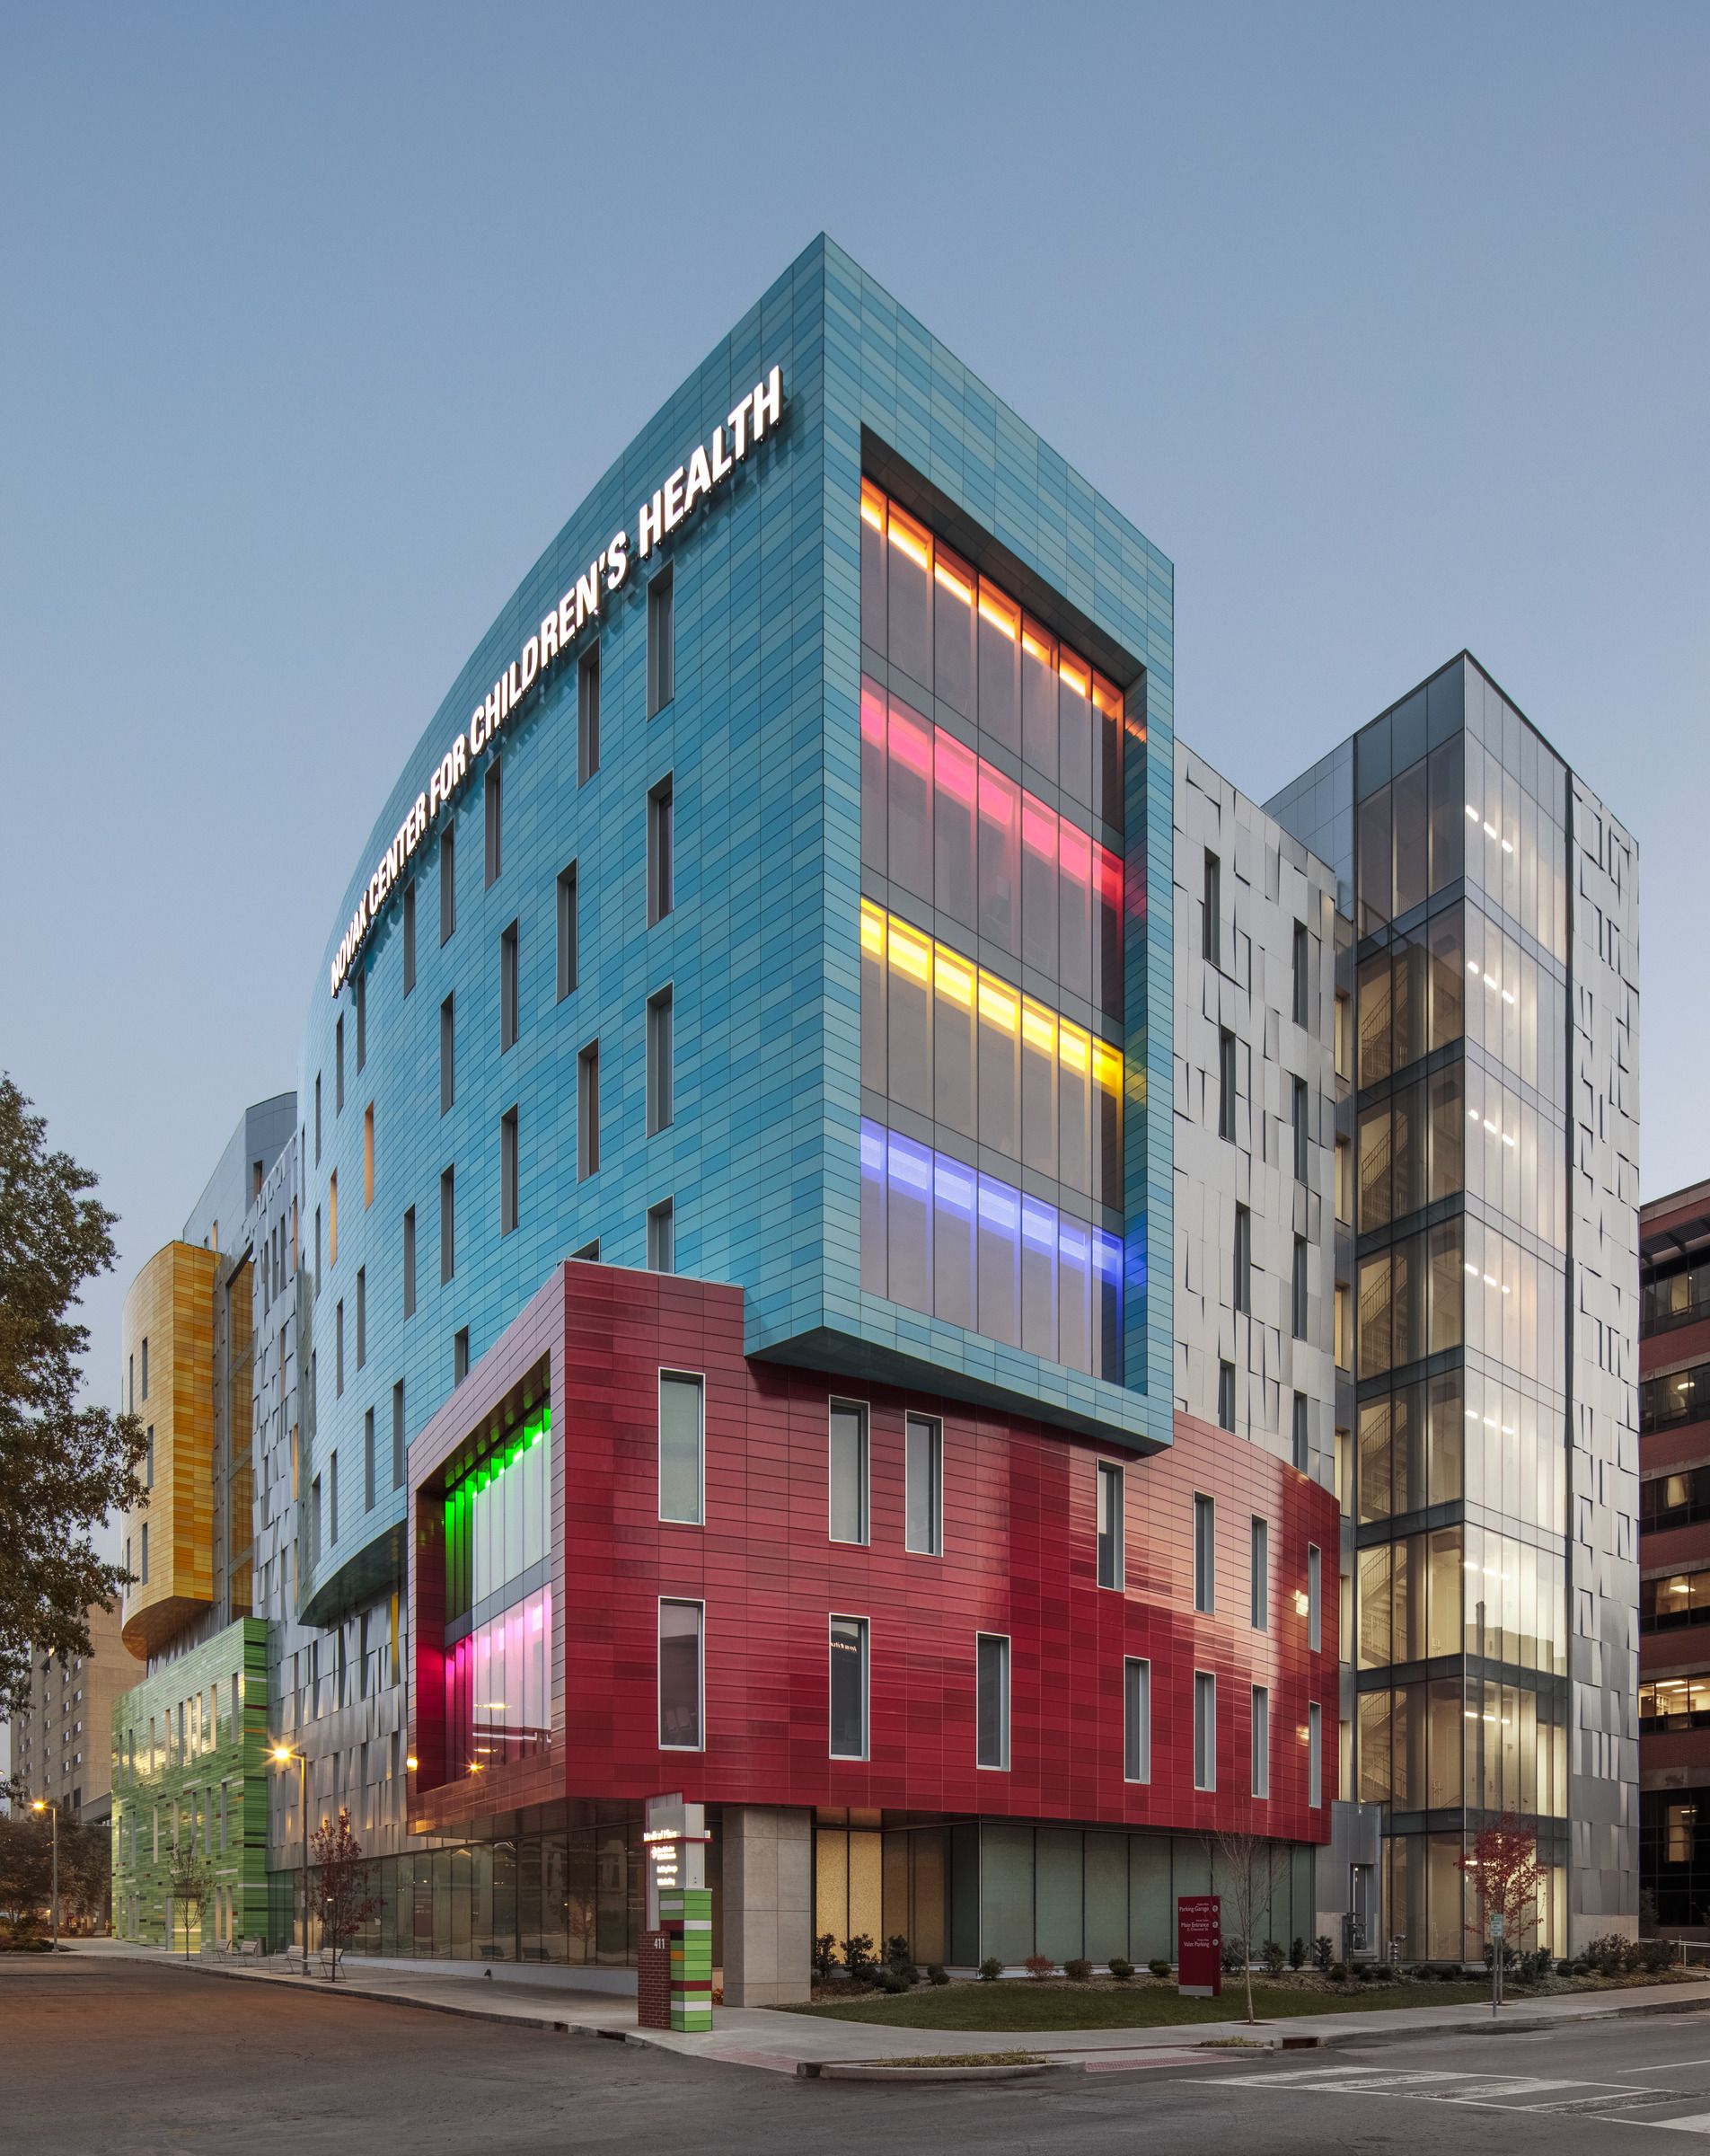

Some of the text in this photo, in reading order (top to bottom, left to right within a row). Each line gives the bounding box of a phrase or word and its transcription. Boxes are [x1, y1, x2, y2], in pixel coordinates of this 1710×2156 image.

[331, 365, 780, 997] NOVAK CENTER FOR CHILDREN'S HEALTH
[654, 1938, 665, 1949] 411
